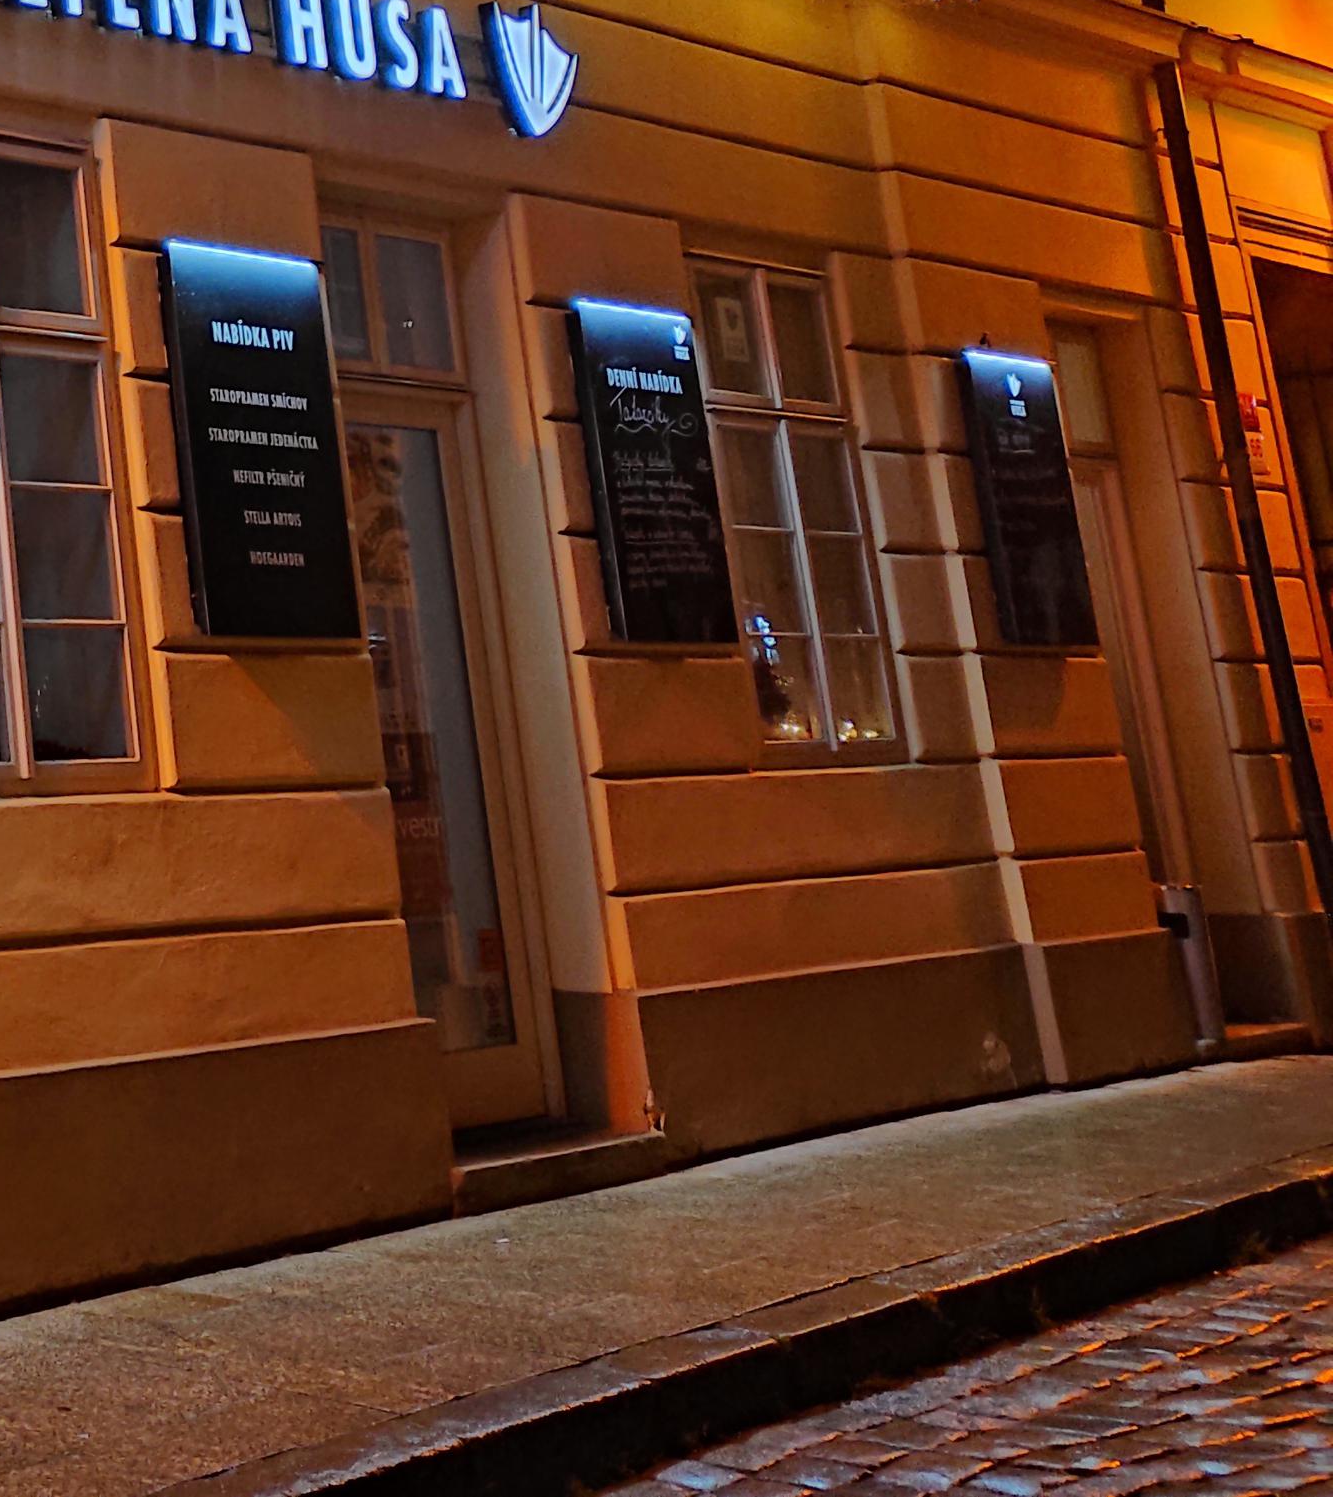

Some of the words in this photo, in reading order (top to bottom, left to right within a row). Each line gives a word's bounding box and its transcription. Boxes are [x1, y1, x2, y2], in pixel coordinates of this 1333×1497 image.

[211, 319, 270, 349] NABÍDKA
[271, 328, 294, 351] PIV
[606, 366, 639, 389] DENNÍ
[639, 370, 683, 394] NABÍDKA
[209, 387, 269, 407] STAROPRAMEN
[271, 392, 308, 411] SMÍCHOV
[208, 426, 268, 445] STAROPRAMEN
[270, 432, 319, 450] JEDENÁCTKA
[233, 469, 265, 485] NEFILTR
[266, 468, 305, 488] PŠENIČNÝ
[244, 510, 271, 525] STELLA
[273, 512, 302, 527] ARTOIS
[249, 550, 305, 567] HOEGAARDEN
